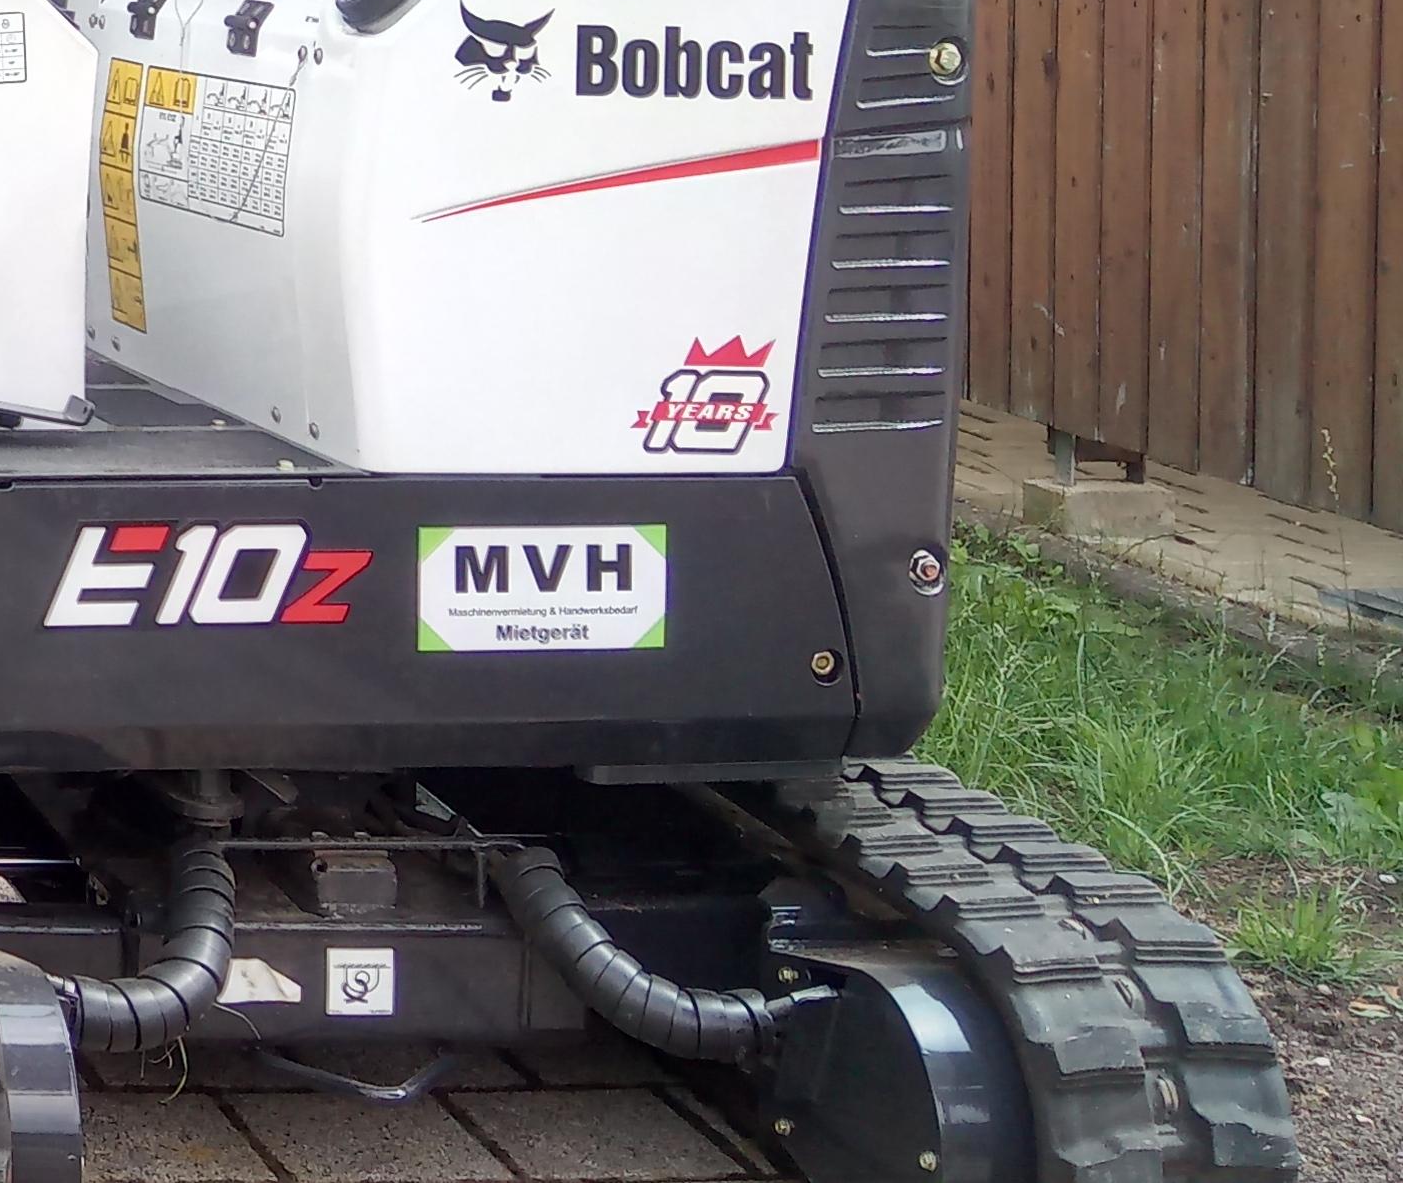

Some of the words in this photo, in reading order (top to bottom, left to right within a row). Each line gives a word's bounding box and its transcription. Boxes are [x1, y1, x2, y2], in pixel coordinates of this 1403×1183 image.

[576, 25, 814, 100] Bobcat
[666, 403, 754, 421] YEARS
[454, 543, 632, 594] MVH
[448, 607, 547, 618] Maschinenvermietung
[549, 607, 557, 616] &
[559, 604, 638, 616] Handwerksbedarf
[496, 623, 590, 645] Mietgerät
